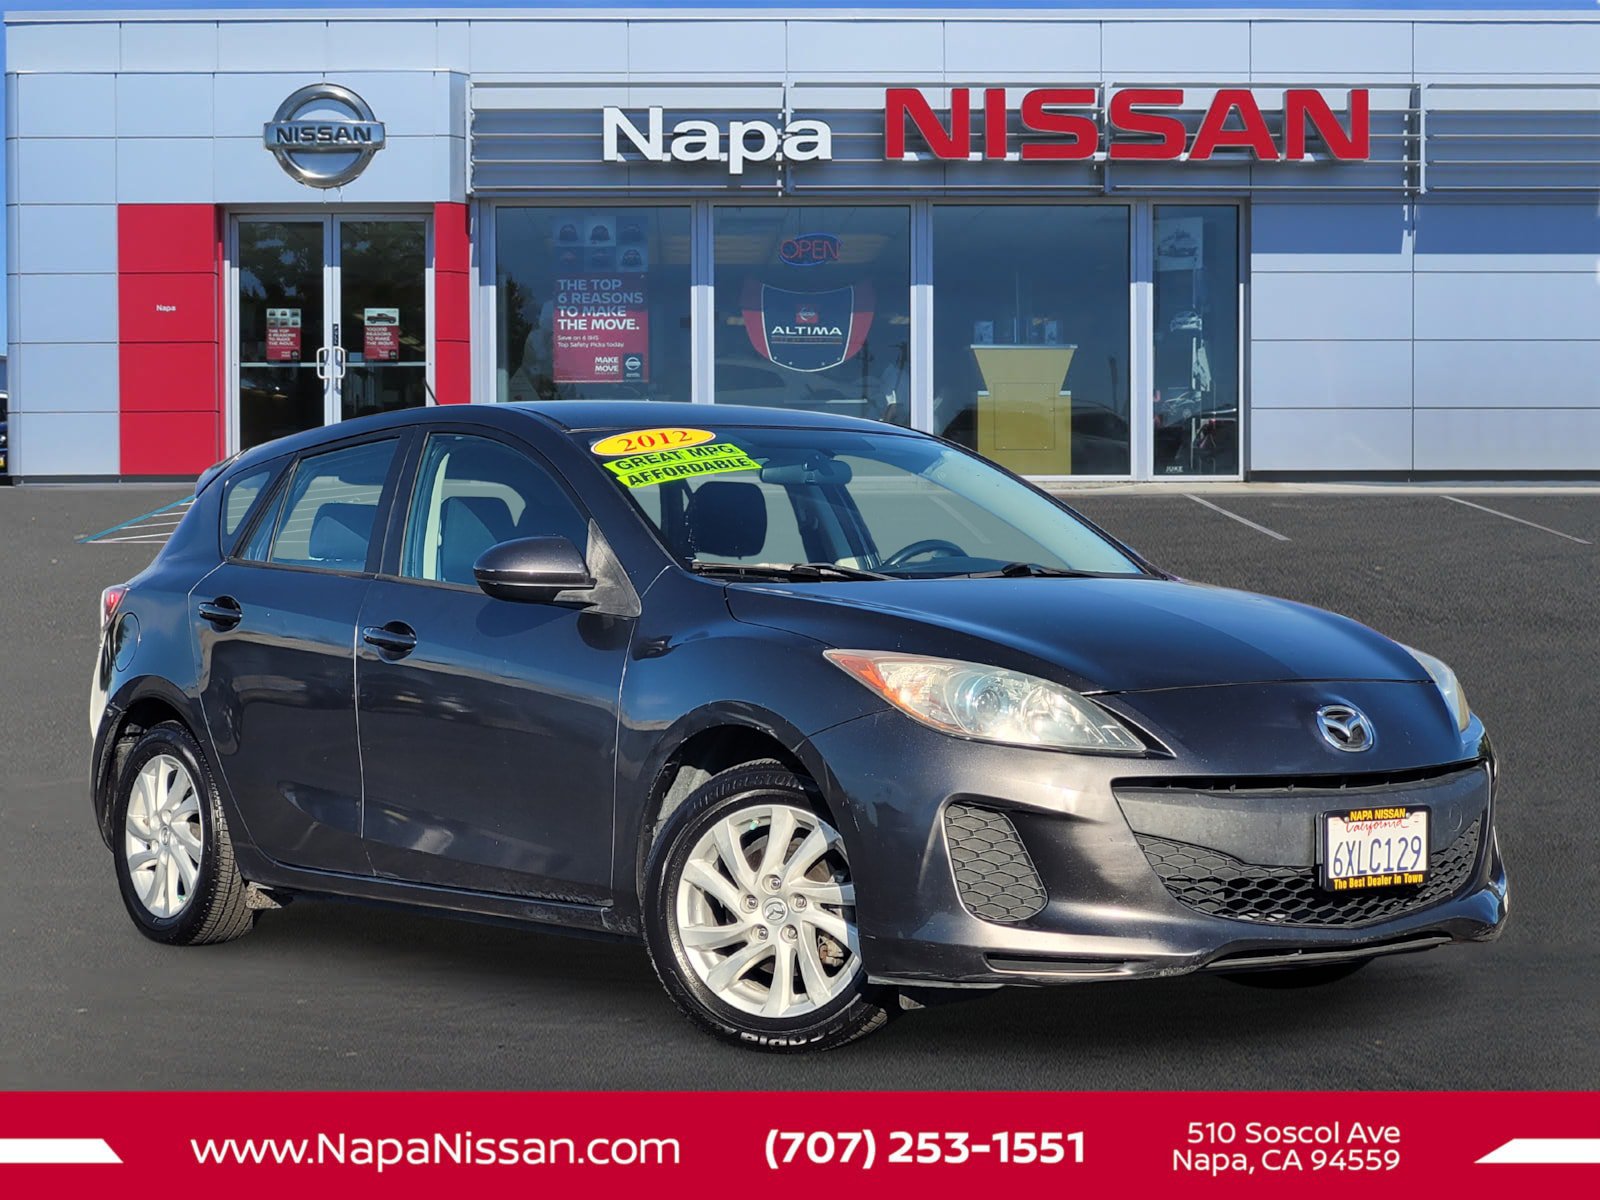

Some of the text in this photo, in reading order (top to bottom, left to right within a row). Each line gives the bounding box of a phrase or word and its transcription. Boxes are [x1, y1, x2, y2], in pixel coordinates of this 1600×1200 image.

[276, 126, 372, 143] NISSAN
[603, 88, 1370, 174] Napa NISSAN
[781, 240, 842, 259] OPEN
[557, 279, 622, 290] THE TOP
[558, 292, 643, 304] 6 REASONS
[156, 304, 176, 312] Napa
[557, 305, 626, 317] TO MAKE
[557, 319, 639, 330] THE MOVE.
[772, 326, 842, 335] ALTIMA
[617, 430, 693, 452] 2012
[616, 445, 734, 470] GREAT MPG
[628, 457, 751, 487] AFFORDABLE
[1350, 808, 1406, 821] NAPA NISSAN
[1333, 836, 1422, 876] 6XLC129
[1334, 879, 1347, 890] The
[1349, 877, 1365, 888] Best
[1367, 875, 1392, 887] Dealer
[1404, 873, 1423, 884] Town
